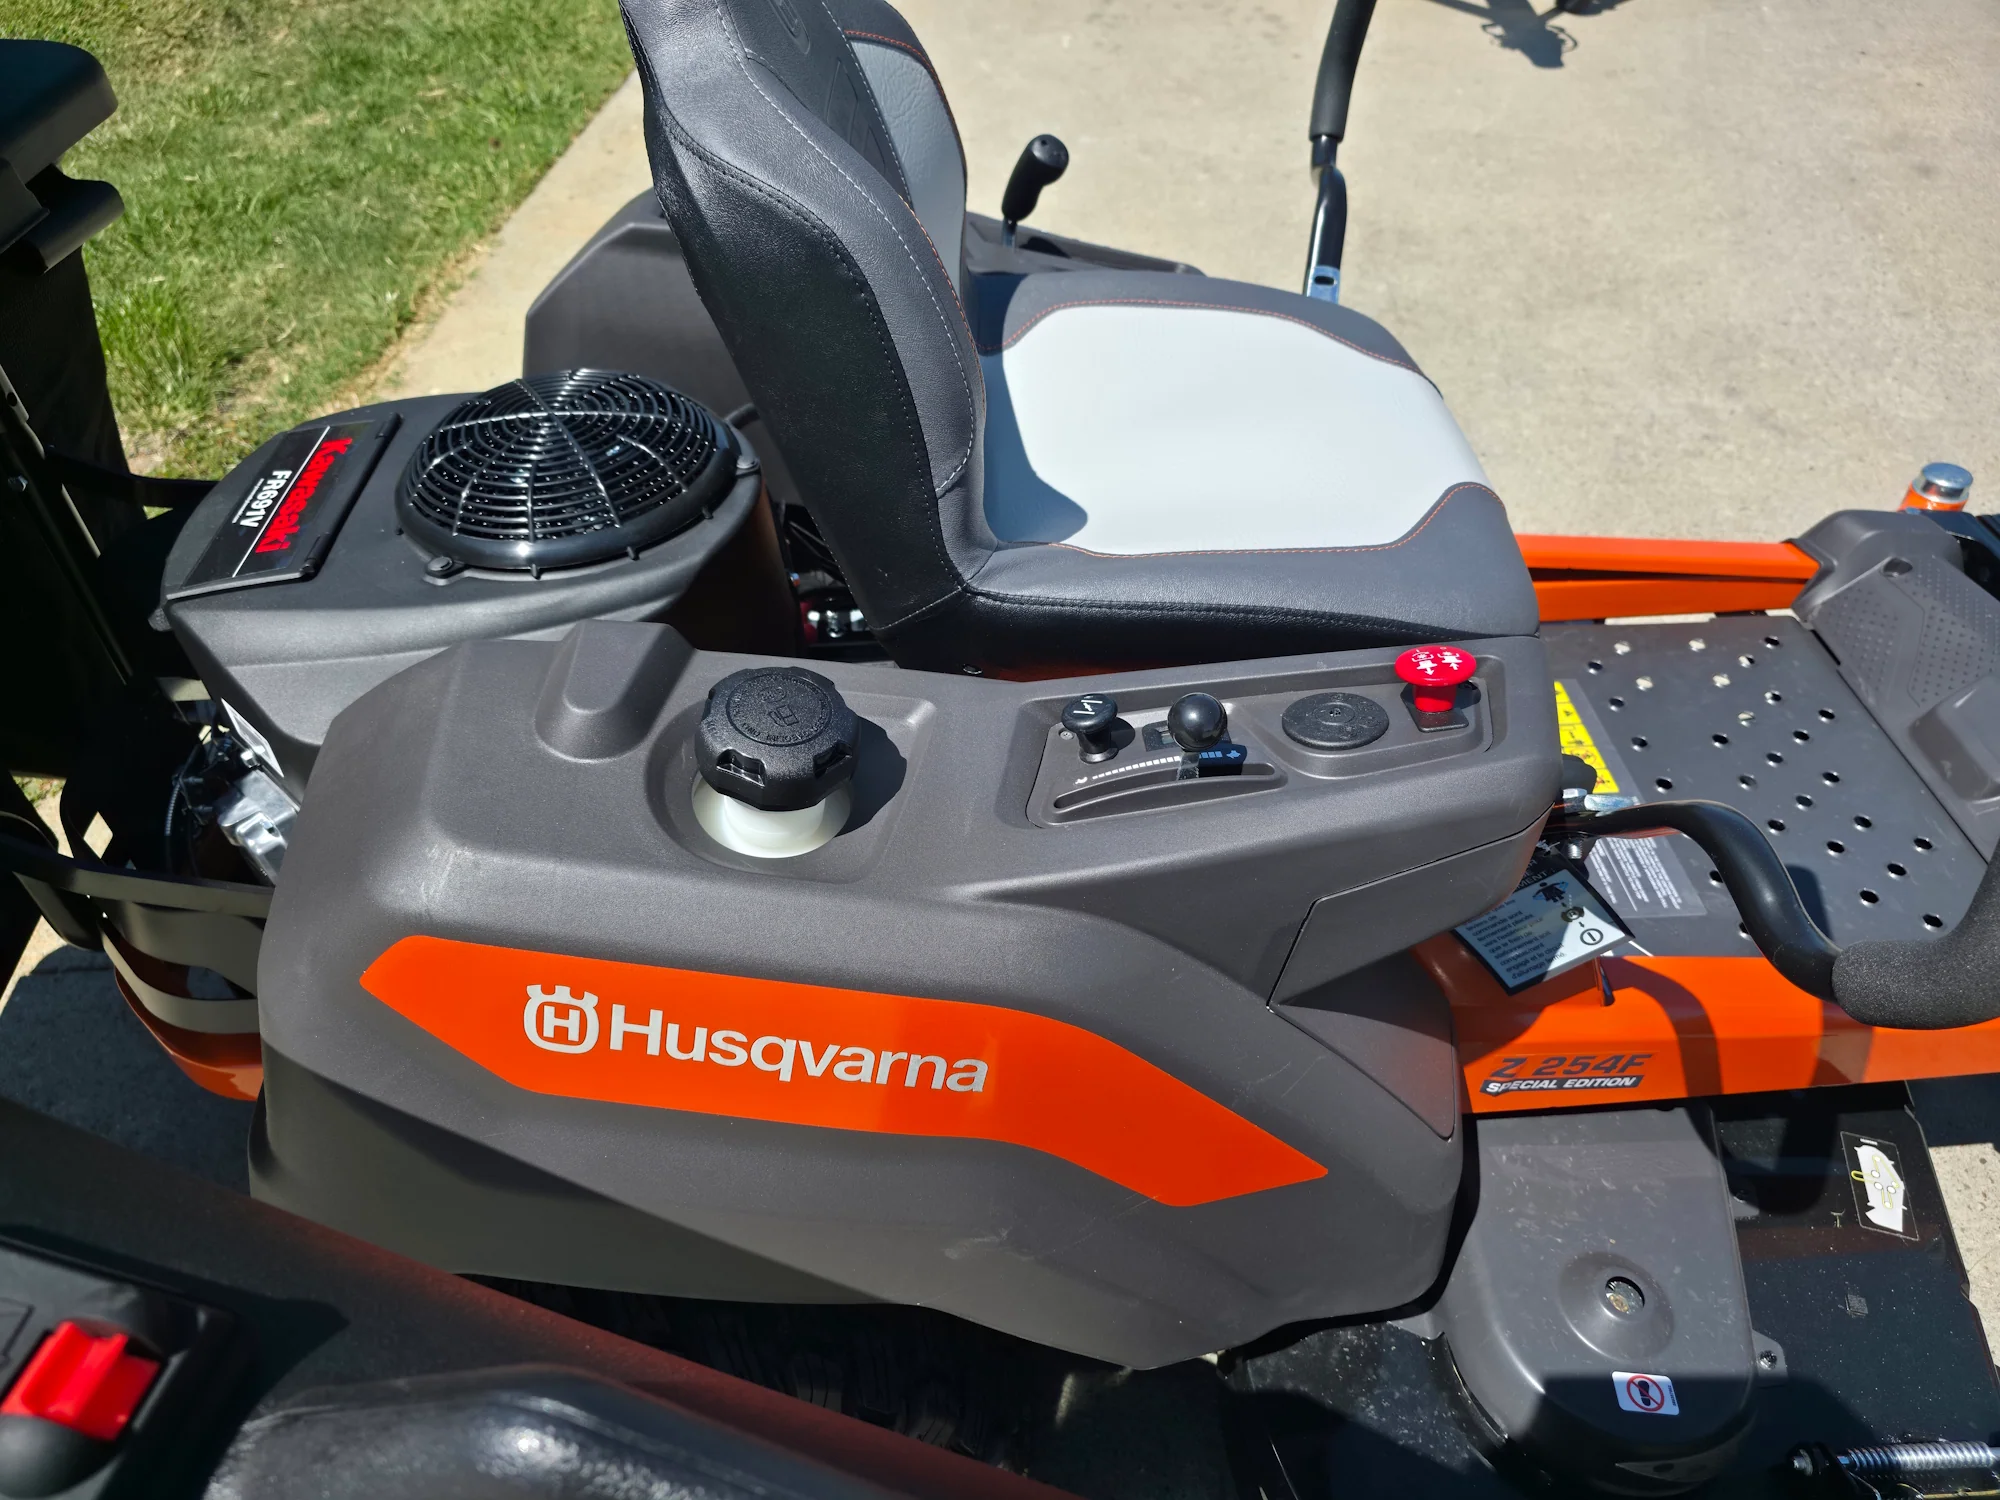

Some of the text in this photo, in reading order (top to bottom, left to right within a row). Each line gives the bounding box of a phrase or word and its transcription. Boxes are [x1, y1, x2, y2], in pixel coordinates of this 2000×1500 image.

[240, 470, 293, 528] FR691V
[255, 437, 353, 554] Kawasaki
[609, 1003, 989, 1093] Husqvarna
[1491, 1053, 1653, 1079] Z 254F
[1486, 1076, 1638, 1093] SPECIAL EDITION
